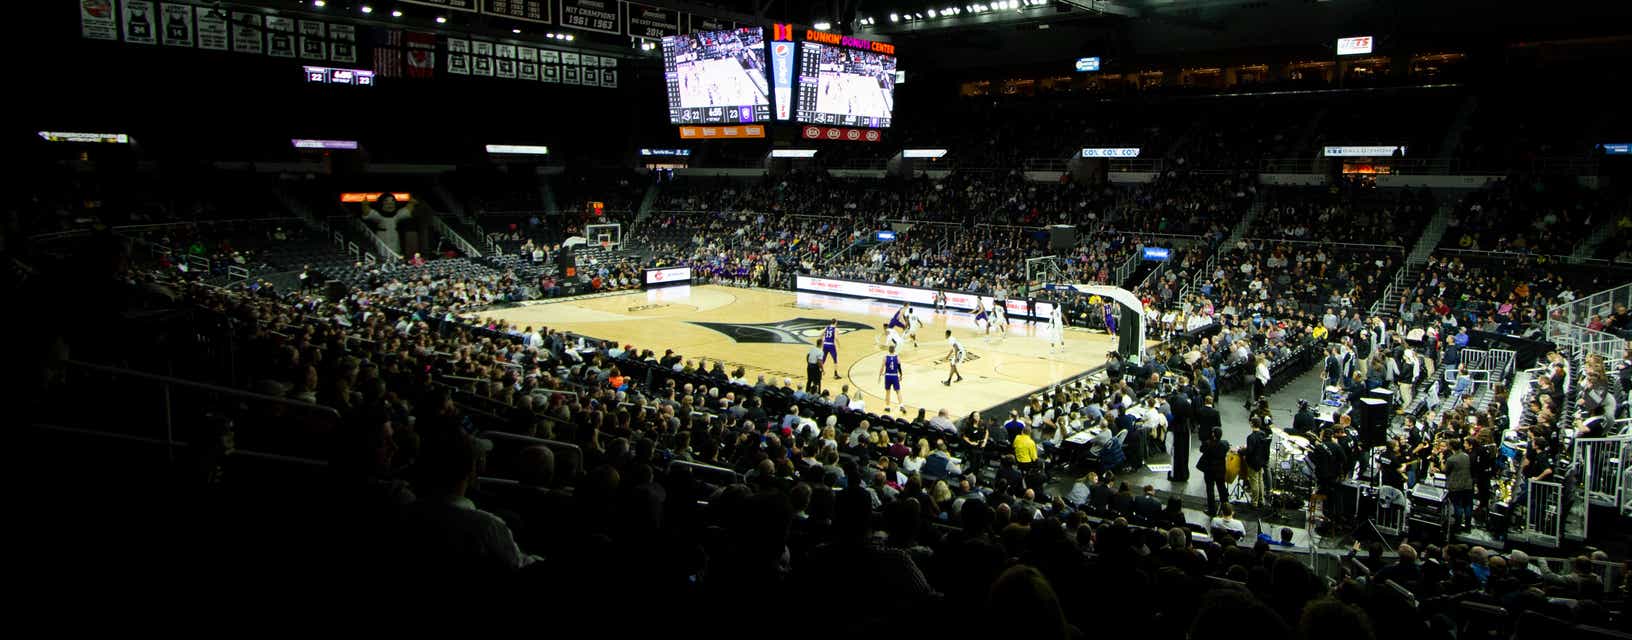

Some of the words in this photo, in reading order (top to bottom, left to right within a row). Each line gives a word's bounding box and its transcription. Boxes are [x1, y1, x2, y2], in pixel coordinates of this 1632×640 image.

[569, 15, 589, 26] 1961
[593, 19, 613, 30] 1963
[646, 27, 664, 37] 2014
[807, 29, 842, 45] DUNKIN'
[842, 35, 870, 49] DONUTS
[871, 40, 895, 54] CENTER
[692, 111, 700, 119] 22
[729, 110, 738, 118] 23
